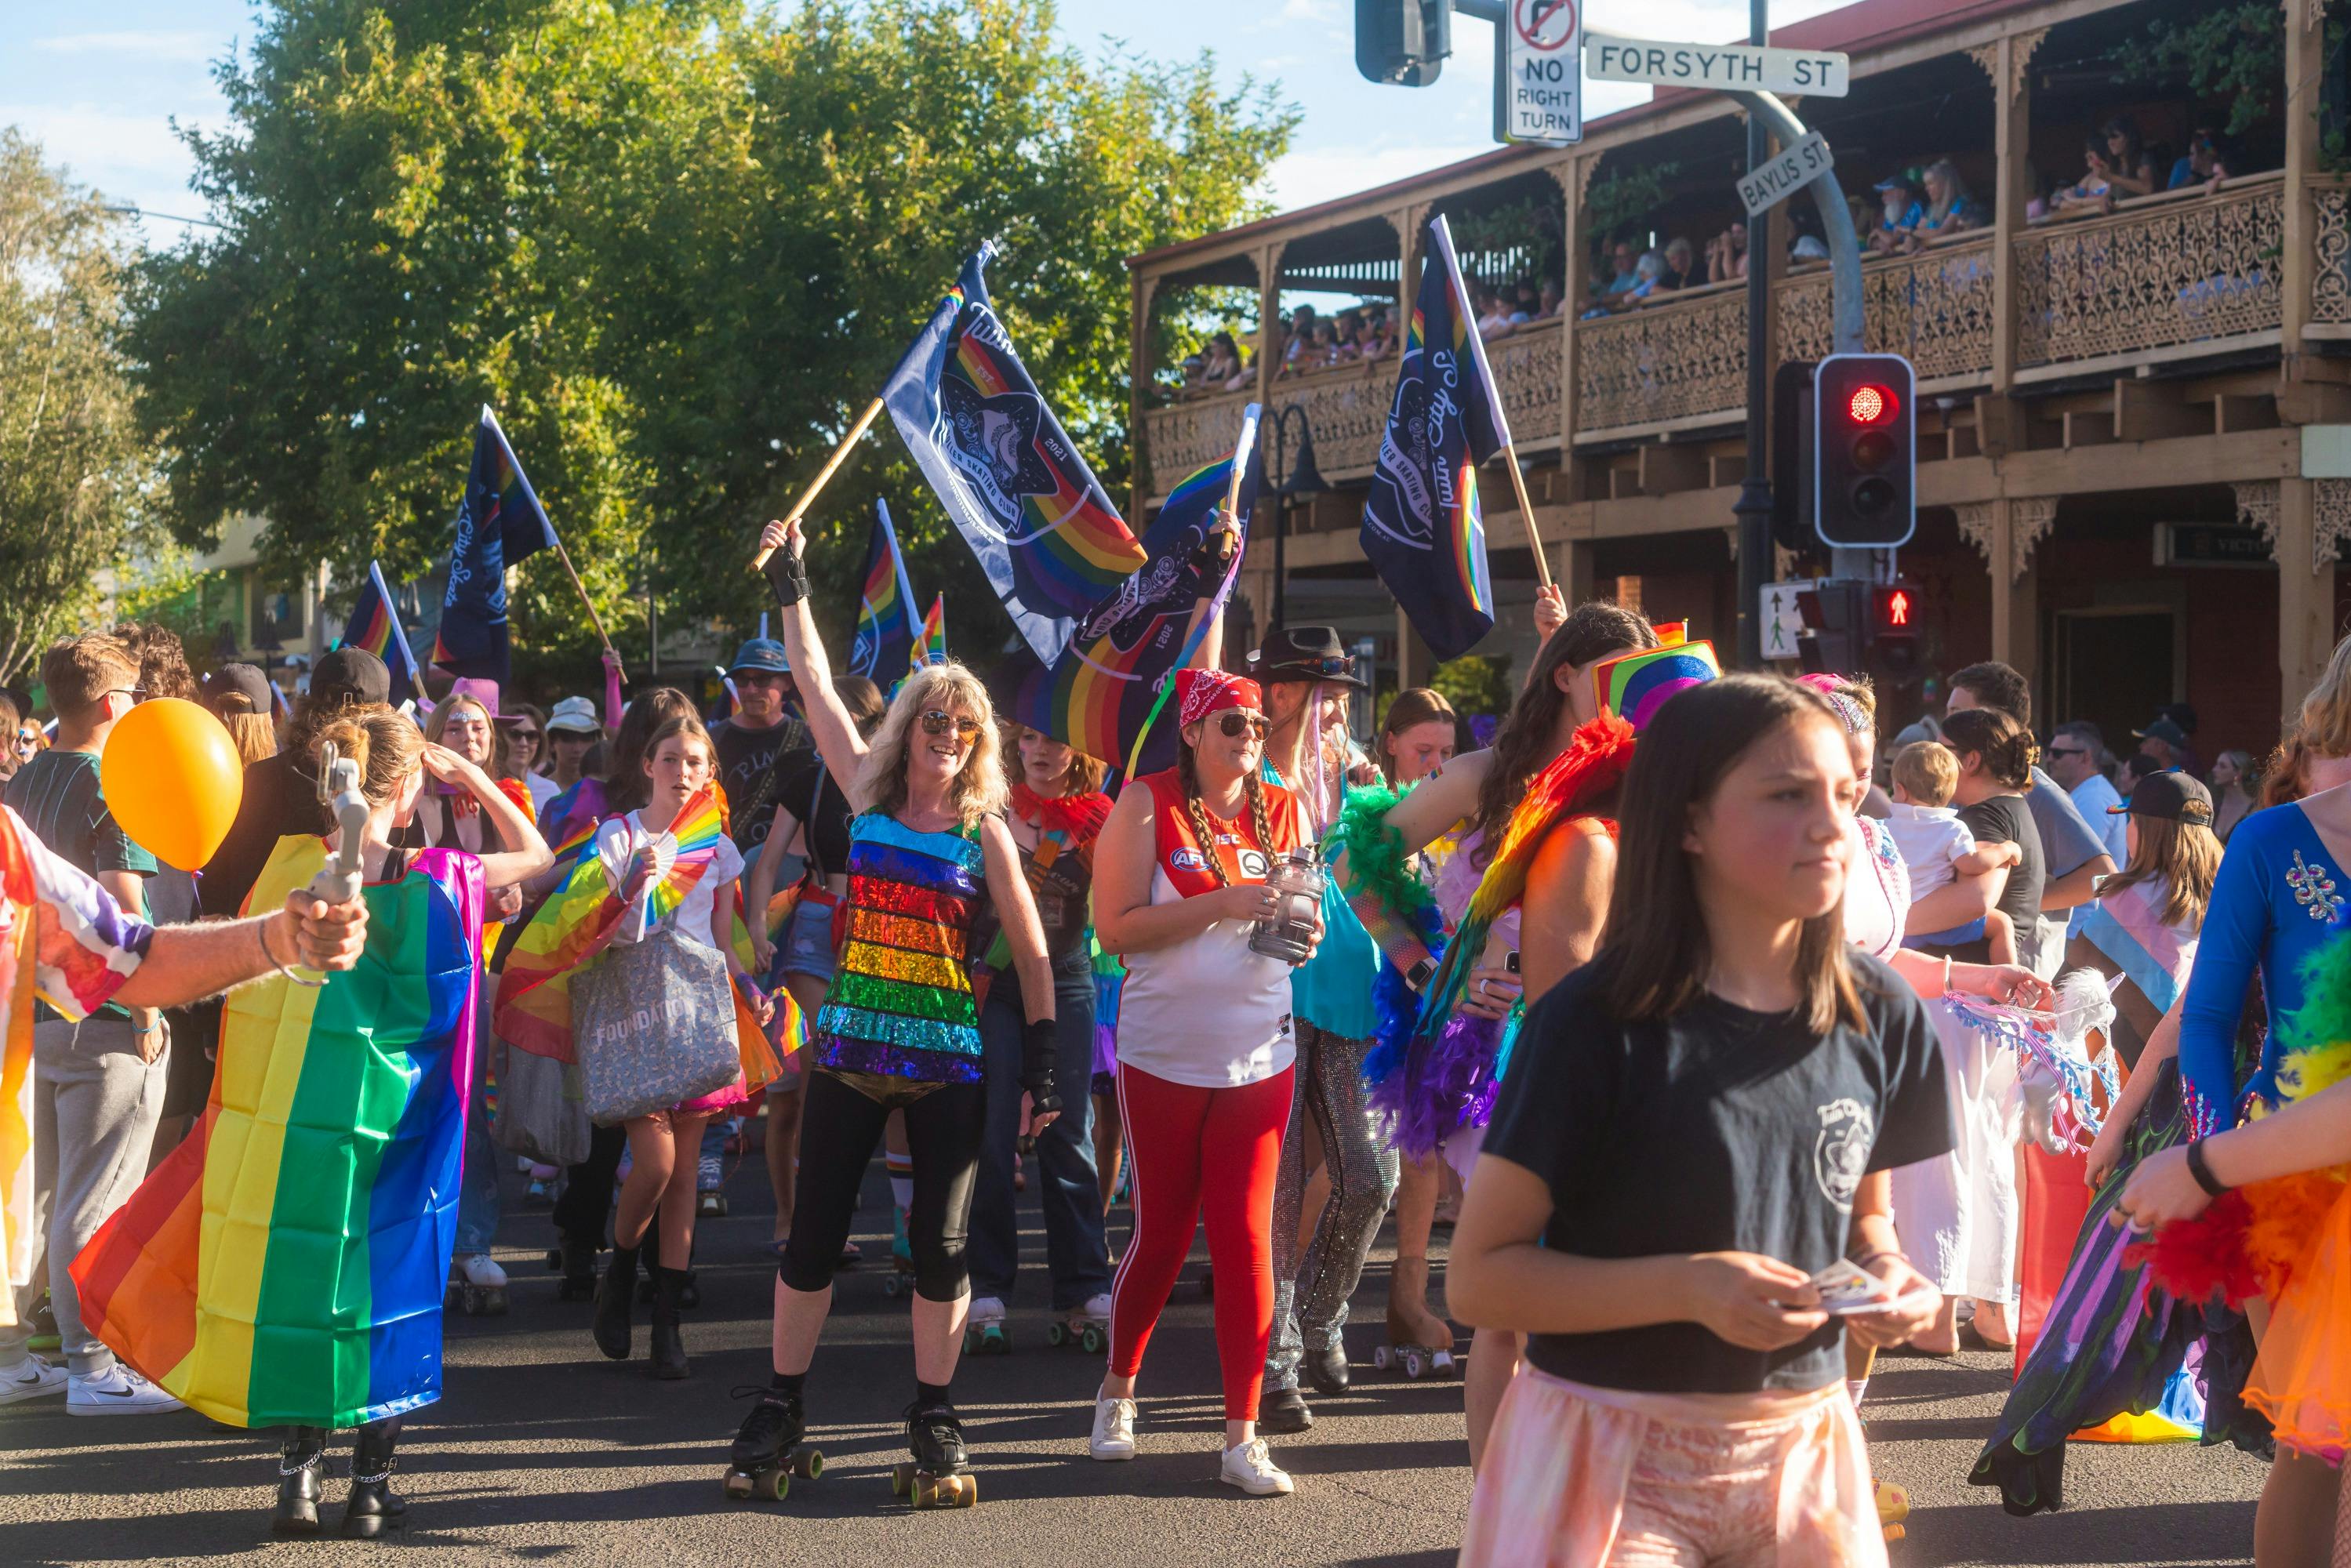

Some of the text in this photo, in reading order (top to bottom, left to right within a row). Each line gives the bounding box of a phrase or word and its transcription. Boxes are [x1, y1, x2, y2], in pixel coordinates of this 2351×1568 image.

[1526, 58, 1563, 82] NO
[1601, 45, 1833, 87] FORSYTH ST
[1517, 88, 1572, 107] RIGHT
[1520, 111, 1571, 130] TURN
[1742, 140, 1825, 208] BAYLIS ST
[961, 302, 1016, 356] Twin
[1427, 387, 1458, 448] City
[1045, 437, 1069, 462] 2021
[967, 459, 997, 497] SKATING
[998, 497, 1016, 517] CLUB
[1396, 459, 1422, 502] SKATING
[445, 559, 471, 608] Skate
[1155, 624, 1174, 650] 2021
[1174, 852, 1208, 866] AFL
[596, 997, 696, 1047] FOUNDATION
